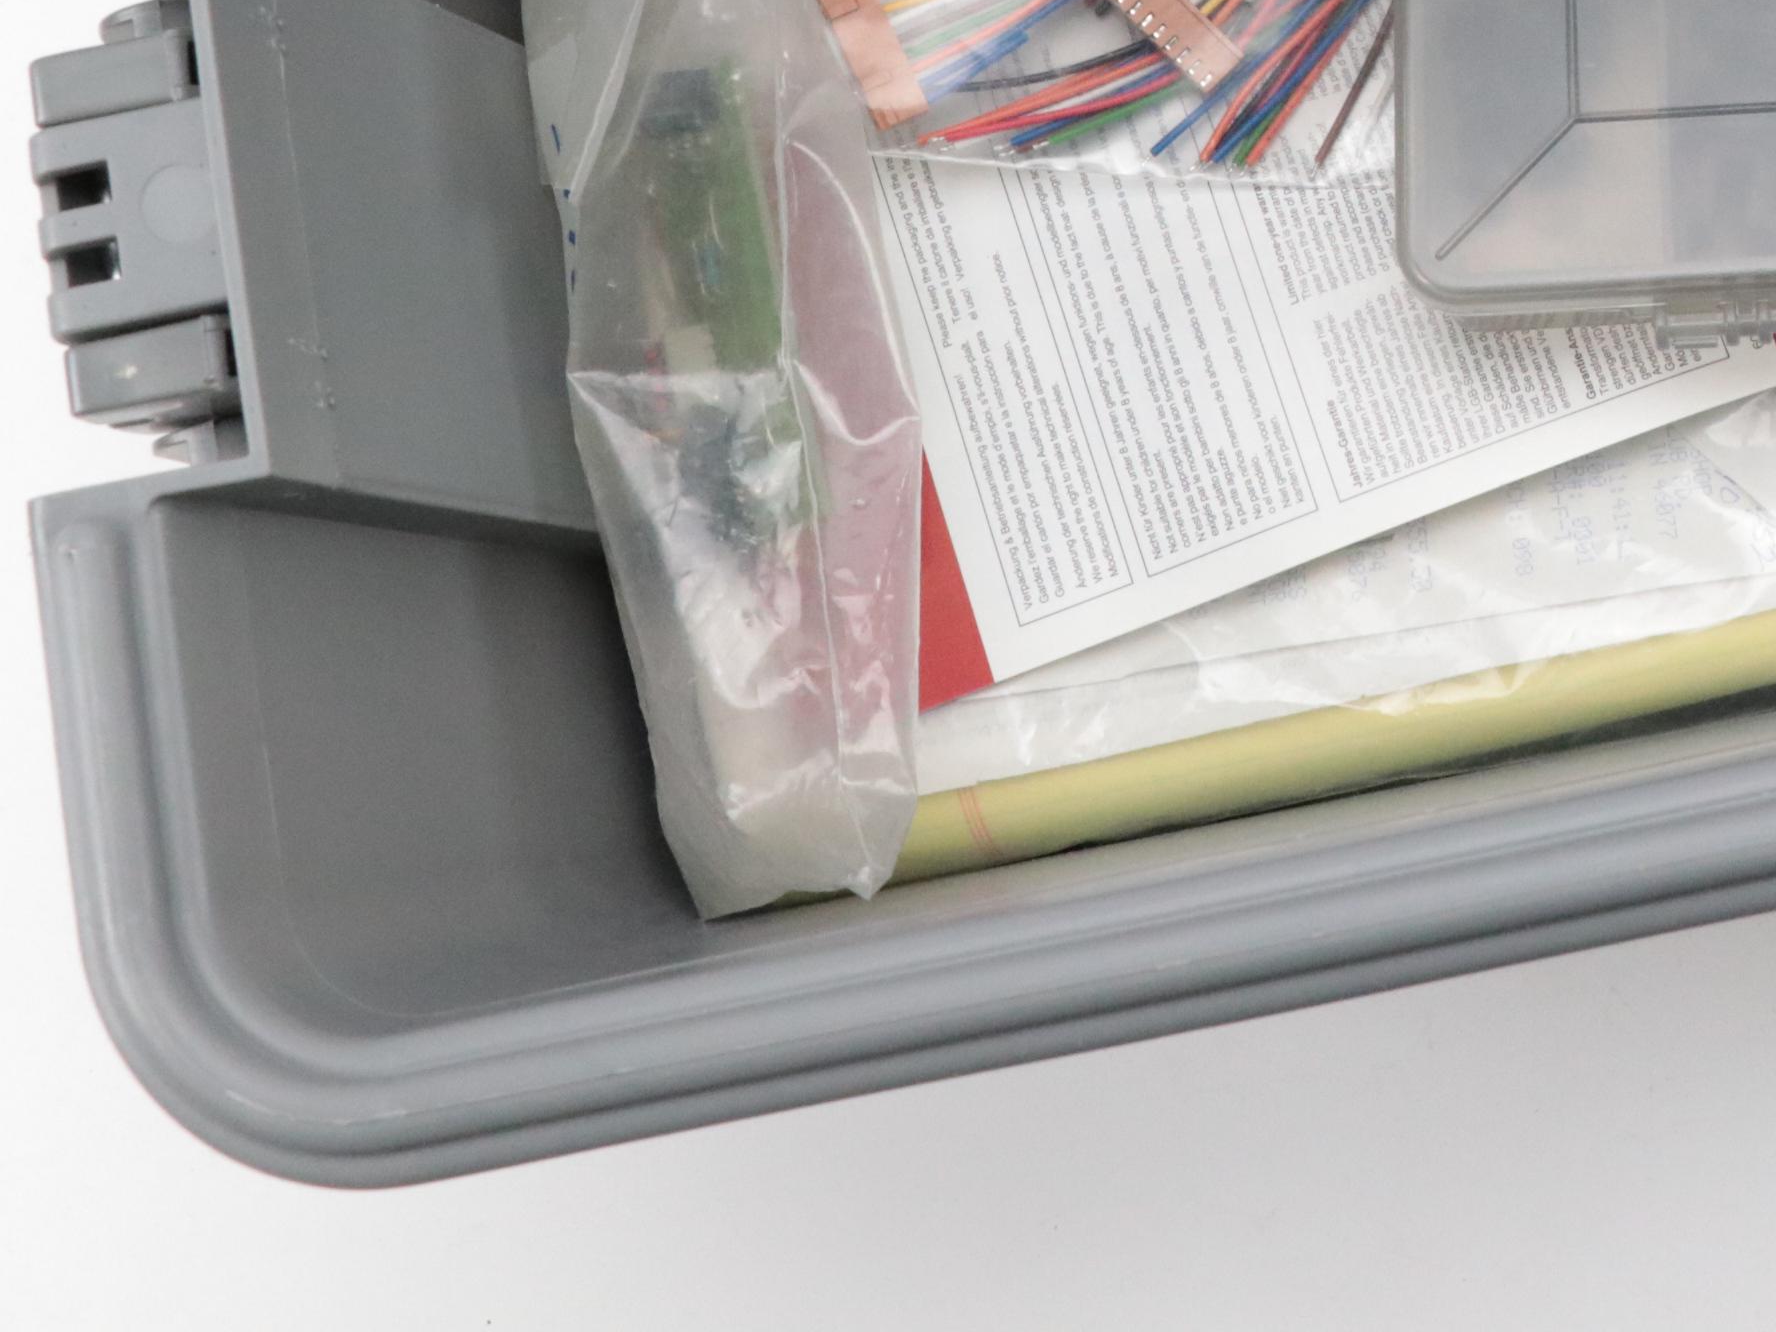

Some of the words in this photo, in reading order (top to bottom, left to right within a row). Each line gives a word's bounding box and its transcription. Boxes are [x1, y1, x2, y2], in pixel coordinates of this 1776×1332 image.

[890, 172, 901, 190] the
[894, 190, 908, 210] and
[903, 212, 927, 264] packaging
[941, 224, 964, 281] Verpakking
[920, 266, 931, 283] the
[930, 242, 947, 279] cartone
[992, 252, 1007, 283] notice.
[926, 284, 939, 310] keep
[945, 288, 960, 324] Tenere
[959, 287, 974, 309] uso!
[1001, 285, 1016, 307] prior
[935, 312, 952, 348] Please
[976, 330, 990, 354] para
[1009, 308, 1026, 343] without
[983, 354, 1005, 408] instrucción
[1004, 340, 1027, 400] vorbehalten.
[1021, 344, 1043, 395] alterations
[954, 375, 982, 442] aufbewahren!
[1037, 396, 1058, 441] technical
[1051, 383, 1072, 433] réservées.
[1022, 400, 1045, 457] Ausführung
[1326, 399, 1362, 487] Jahres-Garantie
[997, 452, 1011, 482] mode
[1007, 431, 1031, 489] empaquetar
[1053, 442, 1067, 470] make
[1067, 434, 1092, 494] construction
[977, 444, 1010, 534] Betriebsanleitung
[1026, 492, 1039, 509] por
[1041, 459, 1065, 520] technischen
[1065, 483, 1079, 506] right
[1032, 509, 1048, 542] cartón
[1060, 521, 1071, 538] der
[1073, 507, 1084, 524] the
[1079, 525, 1096, 563] reserve
[1092, 510, 1118, 577] Modifications
[1008, 545, 1032, 610] Verpackung
[1046, 556, 1064, 597] Guardar
[1066, 538, 1087, 588] Änderung
[1031, 565, 1049, 603] Gardez
